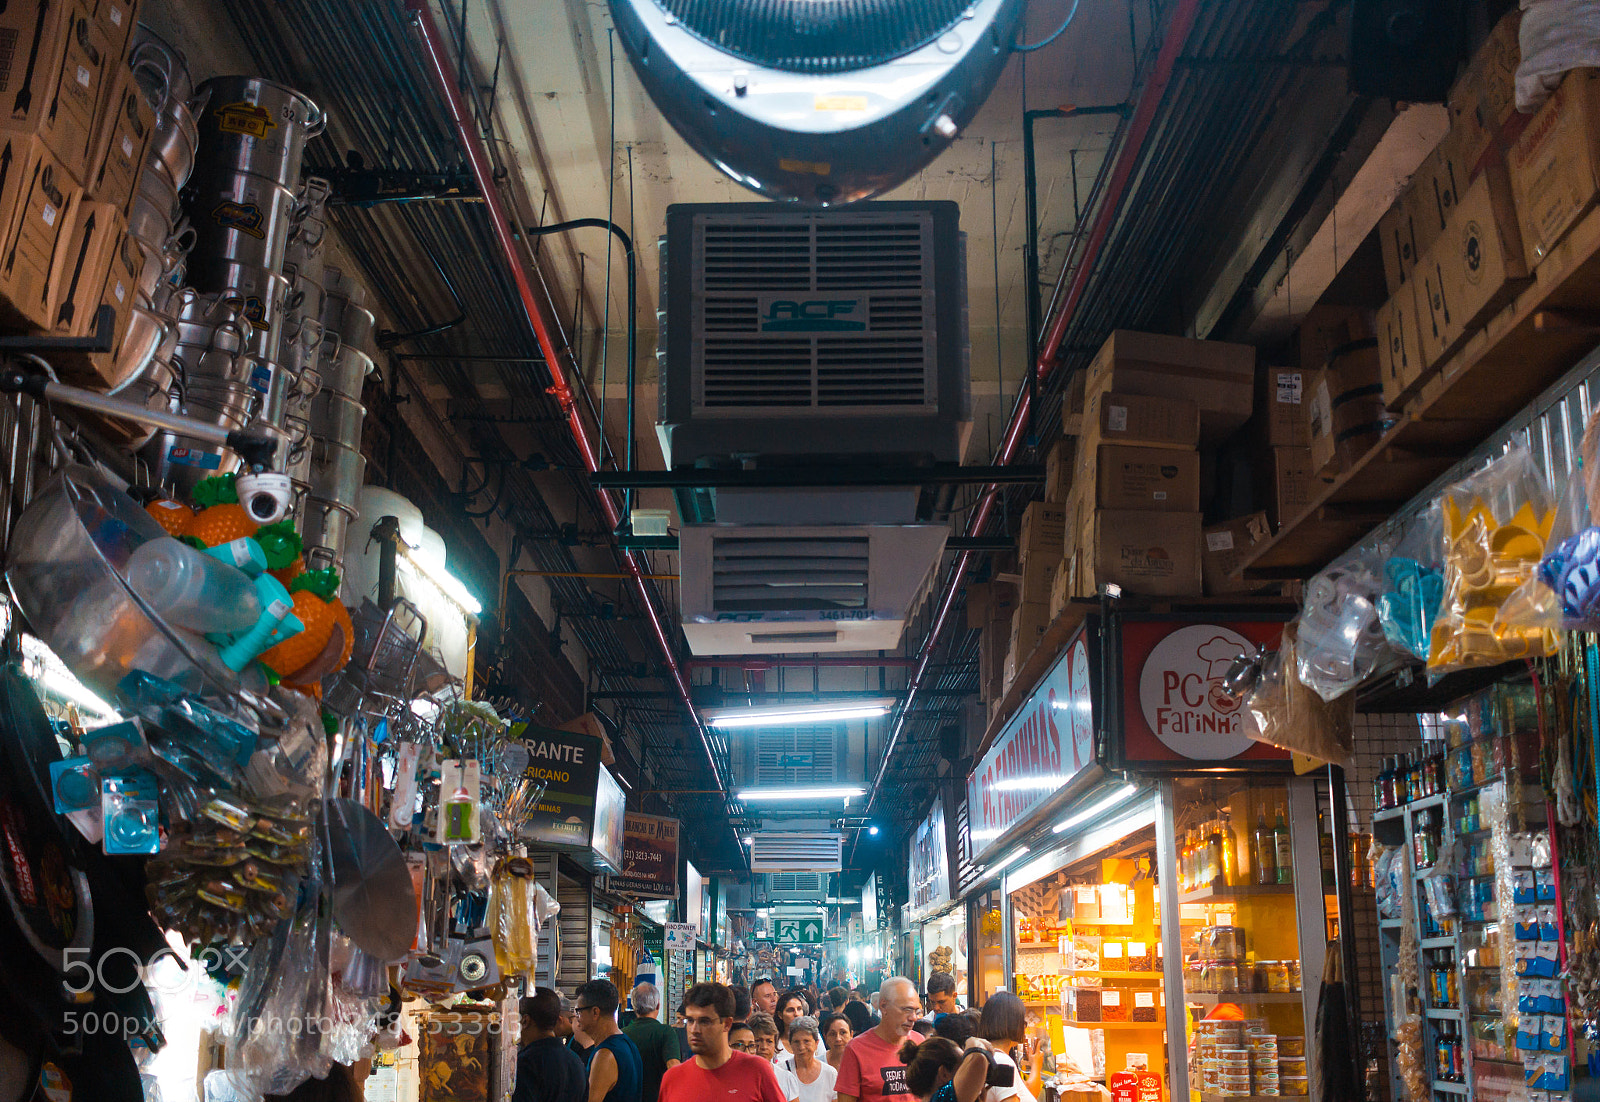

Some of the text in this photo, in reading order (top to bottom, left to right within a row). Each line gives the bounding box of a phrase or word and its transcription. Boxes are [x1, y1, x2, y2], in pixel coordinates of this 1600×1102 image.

[282, 106, 295, 121] 32
[762, 300, 858, 319] ACF
[1163, 670, 1204, 707] PC
[521, 738, 584, 764] RANTE
[996, 688, 1061, 828] FARINHAS
[524, 767, 570, 782] RICANO
[538, 804, 561, 814] MINAS
[877, 876, 886, 929] ERVAS
